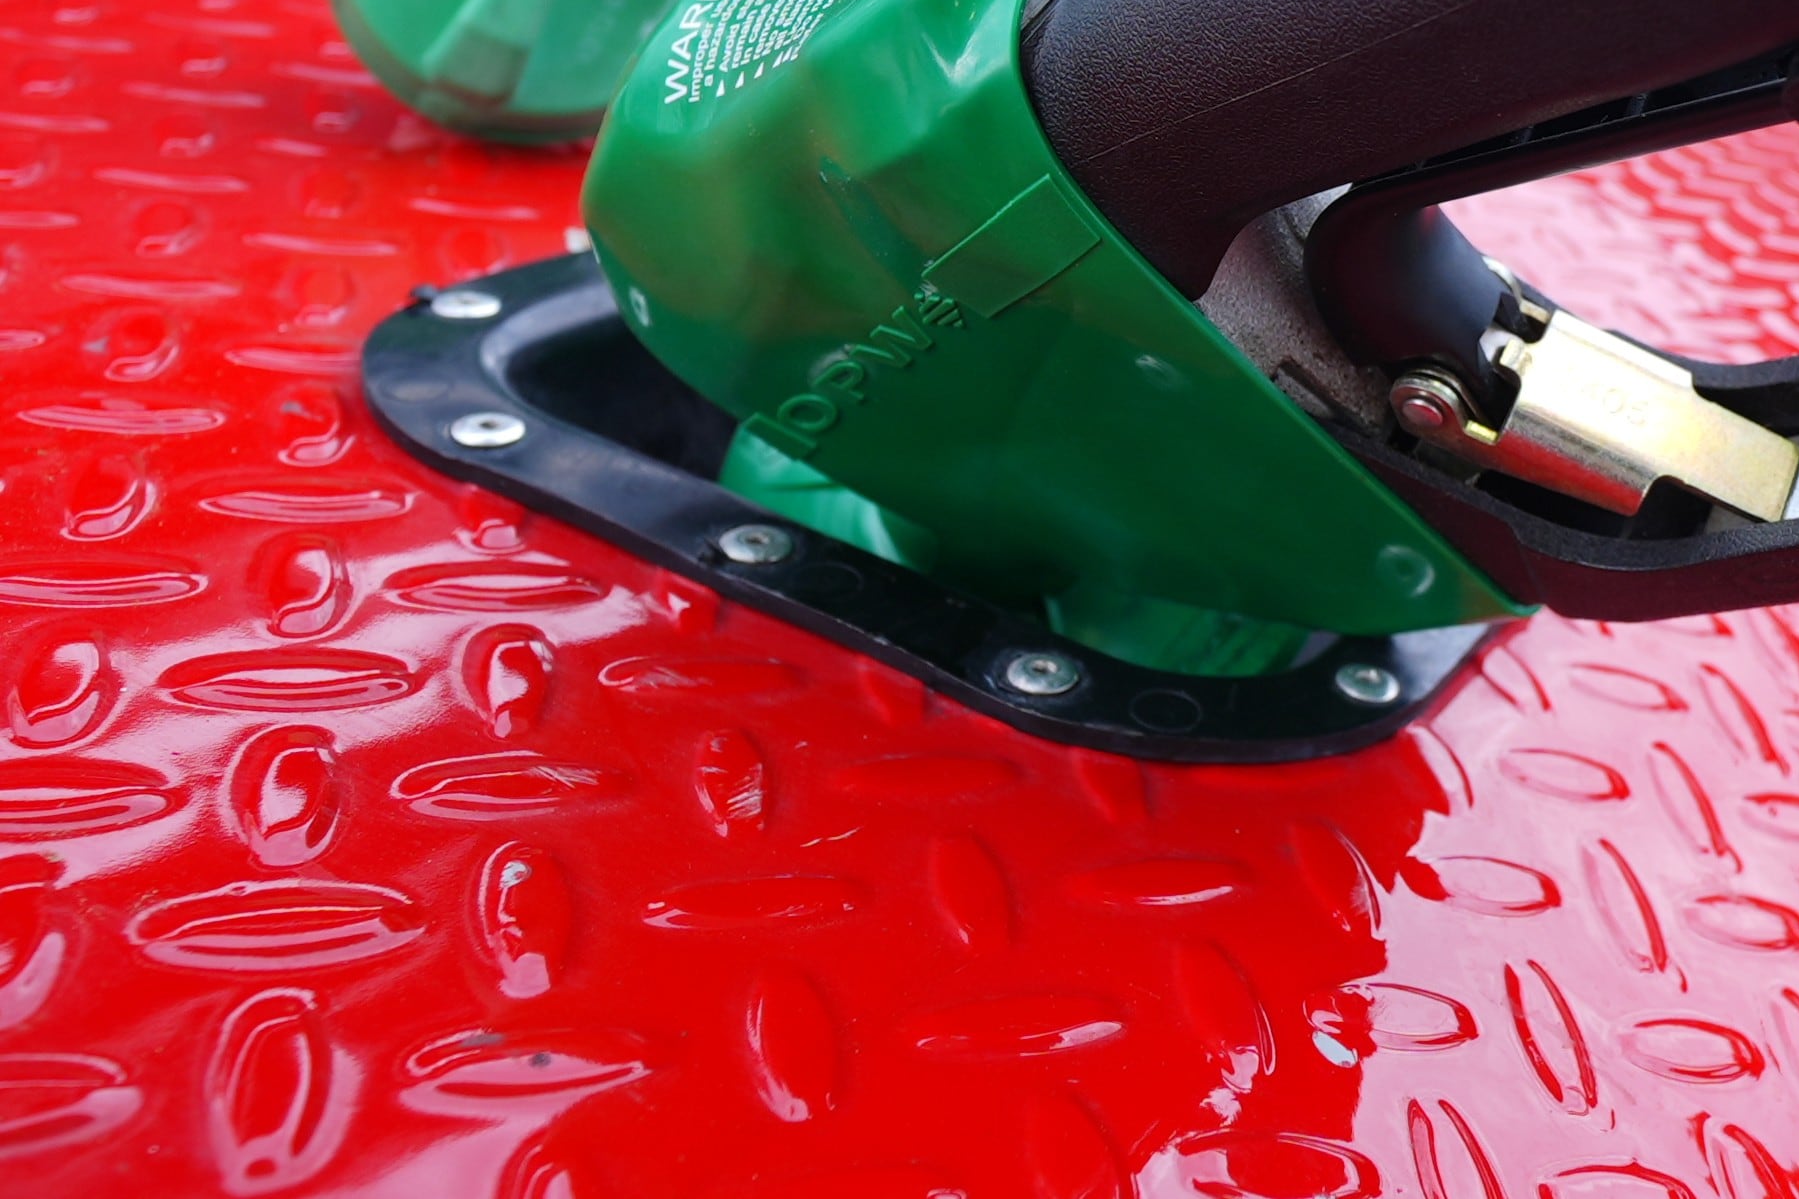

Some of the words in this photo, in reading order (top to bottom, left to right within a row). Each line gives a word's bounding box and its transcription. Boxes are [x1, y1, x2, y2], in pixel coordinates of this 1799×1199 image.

[687, 24, 715, 102] Improper
[718, 23, 739, 72] Avoid
[732, 10, 758, 69] remain
[739, 46, 753, 64] In
[748, 3, 771, 43] case
[704, 73, 713, 86] a
